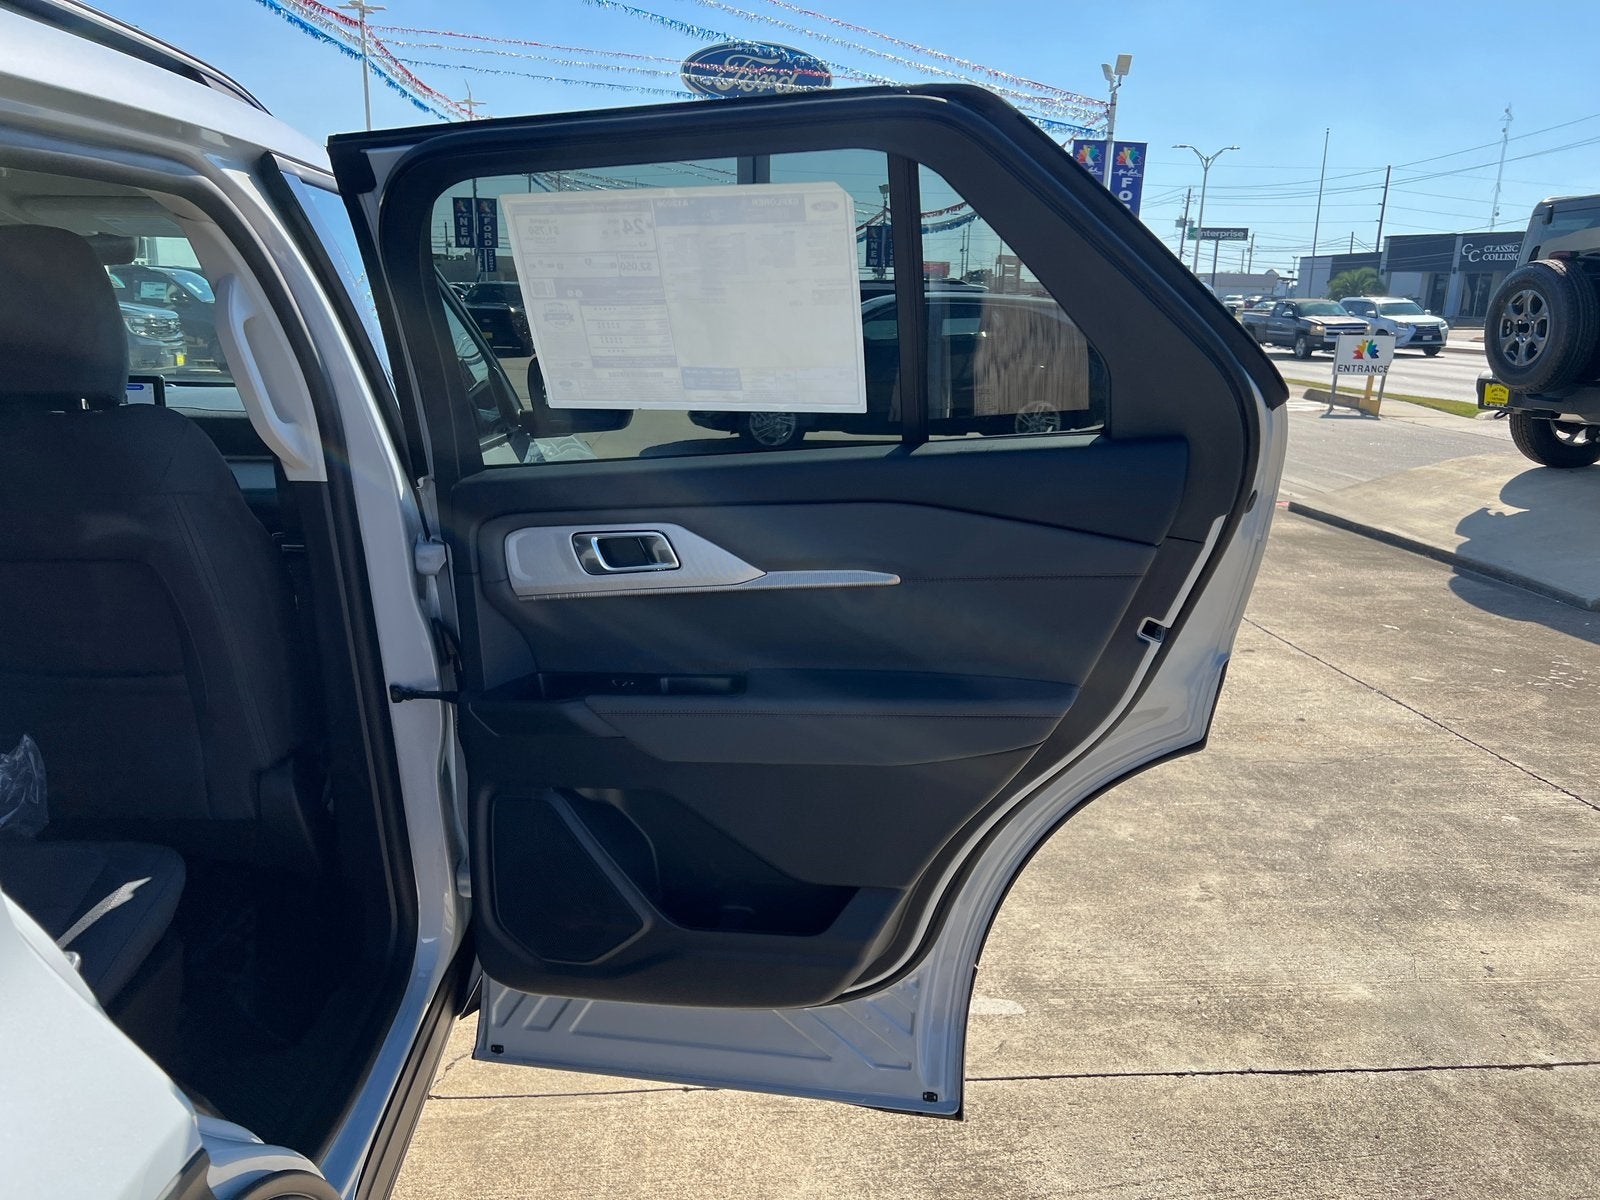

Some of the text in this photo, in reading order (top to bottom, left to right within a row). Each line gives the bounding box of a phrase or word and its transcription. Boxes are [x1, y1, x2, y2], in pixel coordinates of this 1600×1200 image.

[715, 55, 804, 93] Ford
[459, 217, 470, 245] NEW
[483, 217, 492, 246] FORD
[1483, 244, 1519, 253] CLASSIC
[1337, 364, 1390, 374] ENTRANCE
